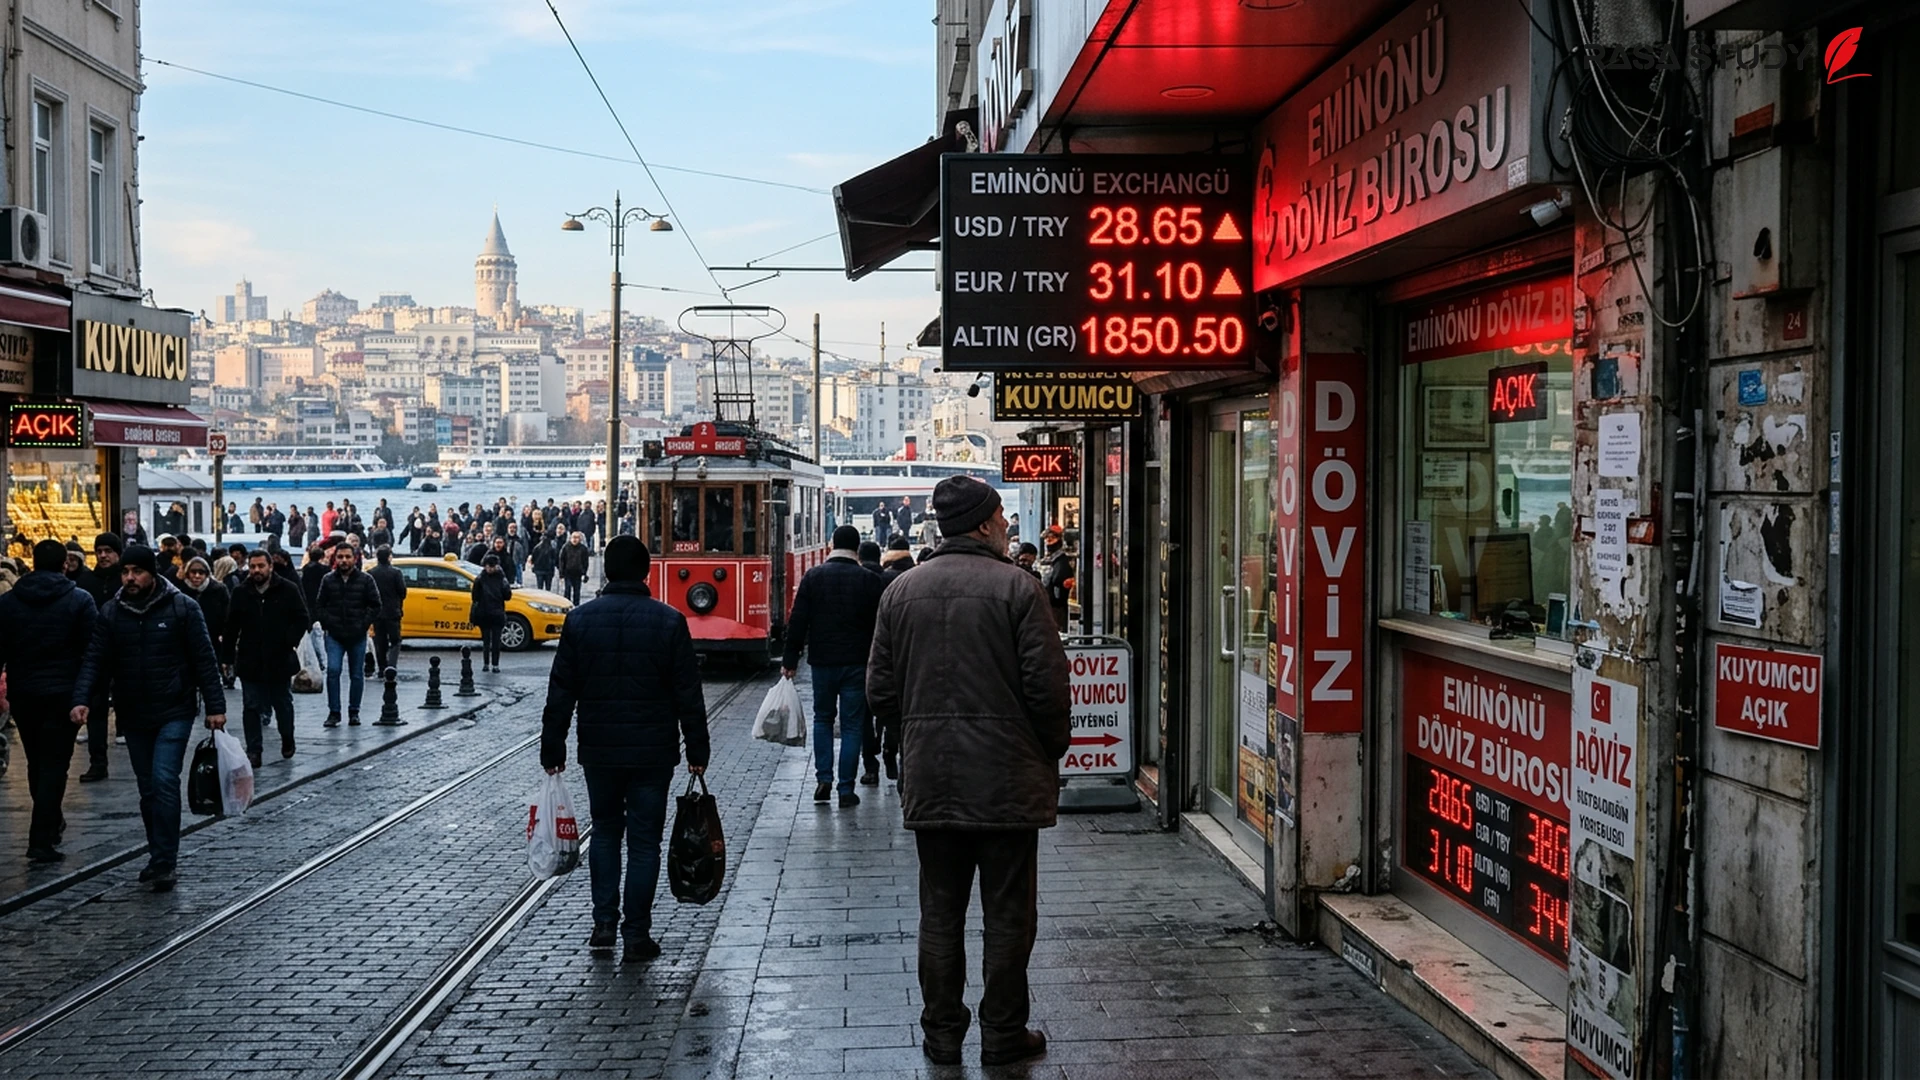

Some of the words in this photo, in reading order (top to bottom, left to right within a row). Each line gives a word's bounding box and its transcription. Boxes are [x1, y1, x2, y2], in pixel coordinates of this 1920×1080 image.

[1308, 4, 1444, 167] EMİNÖNÜ
[971, 167, 1084, 194] EMİNÖNÜ
[1093, 168, 1230, 195] EXCHANGÜ
[1280, 164, 1354, 260] DÖVİZ
[1361, 86, 1506, 226] BÜROSU
[954, 216, 1002, 237] USD
[1023, 216, 1069, 237] TRY
[1088, 206, 1203, 245] 28.65
[954, 271, 1004, 293] EUR
[1023, 271, 1069, 293] TRY
[1089, 262, 1203, 300] 31.10
[952, 325, 1019, 347] ALTIN
[1026, 325, 1077, 352] (GR)
[1081, 316, 1243, 355] 1850.50
[1408, 297, 1481, 352] EMİNÖNÜ
[1487, 284, 1545, 338] DÖVİZ
[86, 320, 188, 382] KUYUMCU
[1005, 385, 1133, 410] KUYUMCU
[1492, 373, 1536, 417] AÇIK
[16, 414, 75, 440] AÇIK
[1012, 454, 1063, 477] AÇIK
[1280, 391, 1296, 696] DÖVİZ
[1311, 380, 1357, 702] DÖVİZ
[1070, 683, 1126, 705] YUMCU
[1720, 656, 1817, 694] KUYUMCU
[1443, 675, 1545, 741] EMİNÖNÜ
[1741, 695, 1788, 729] AÇIK
[1418, 714, 1475, 769] DÖVİZ
[1064, 753, 1118, 771] AÇIK
[1571, 1009, 1632, 1078] KUYUMCU
